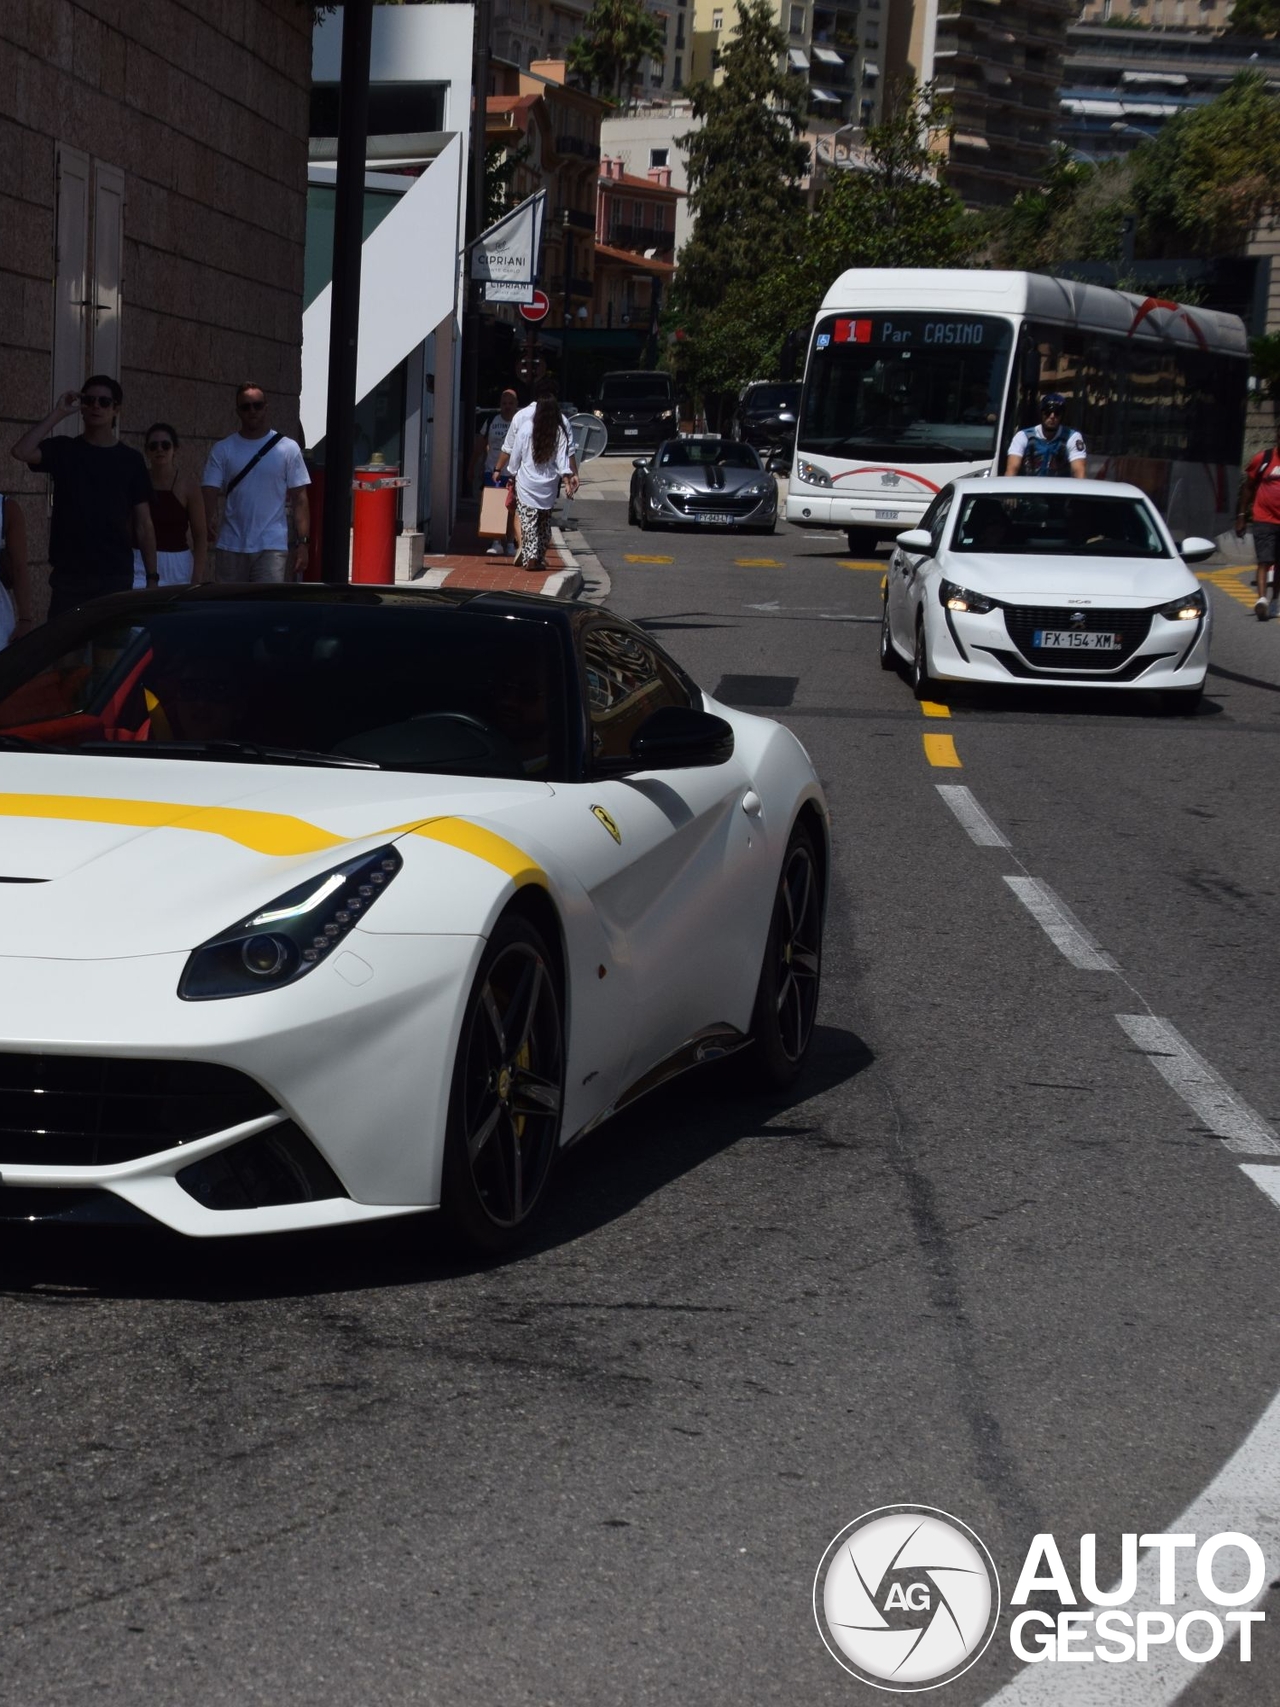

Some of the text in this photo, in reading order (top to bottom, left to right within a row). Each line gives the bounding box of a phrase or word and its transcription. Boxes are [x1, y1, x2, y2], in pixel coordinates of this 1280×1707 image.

[478, 255, 526, 266] CIPRIANI
[847, 321, 983, 344] 1 Par CASINO
